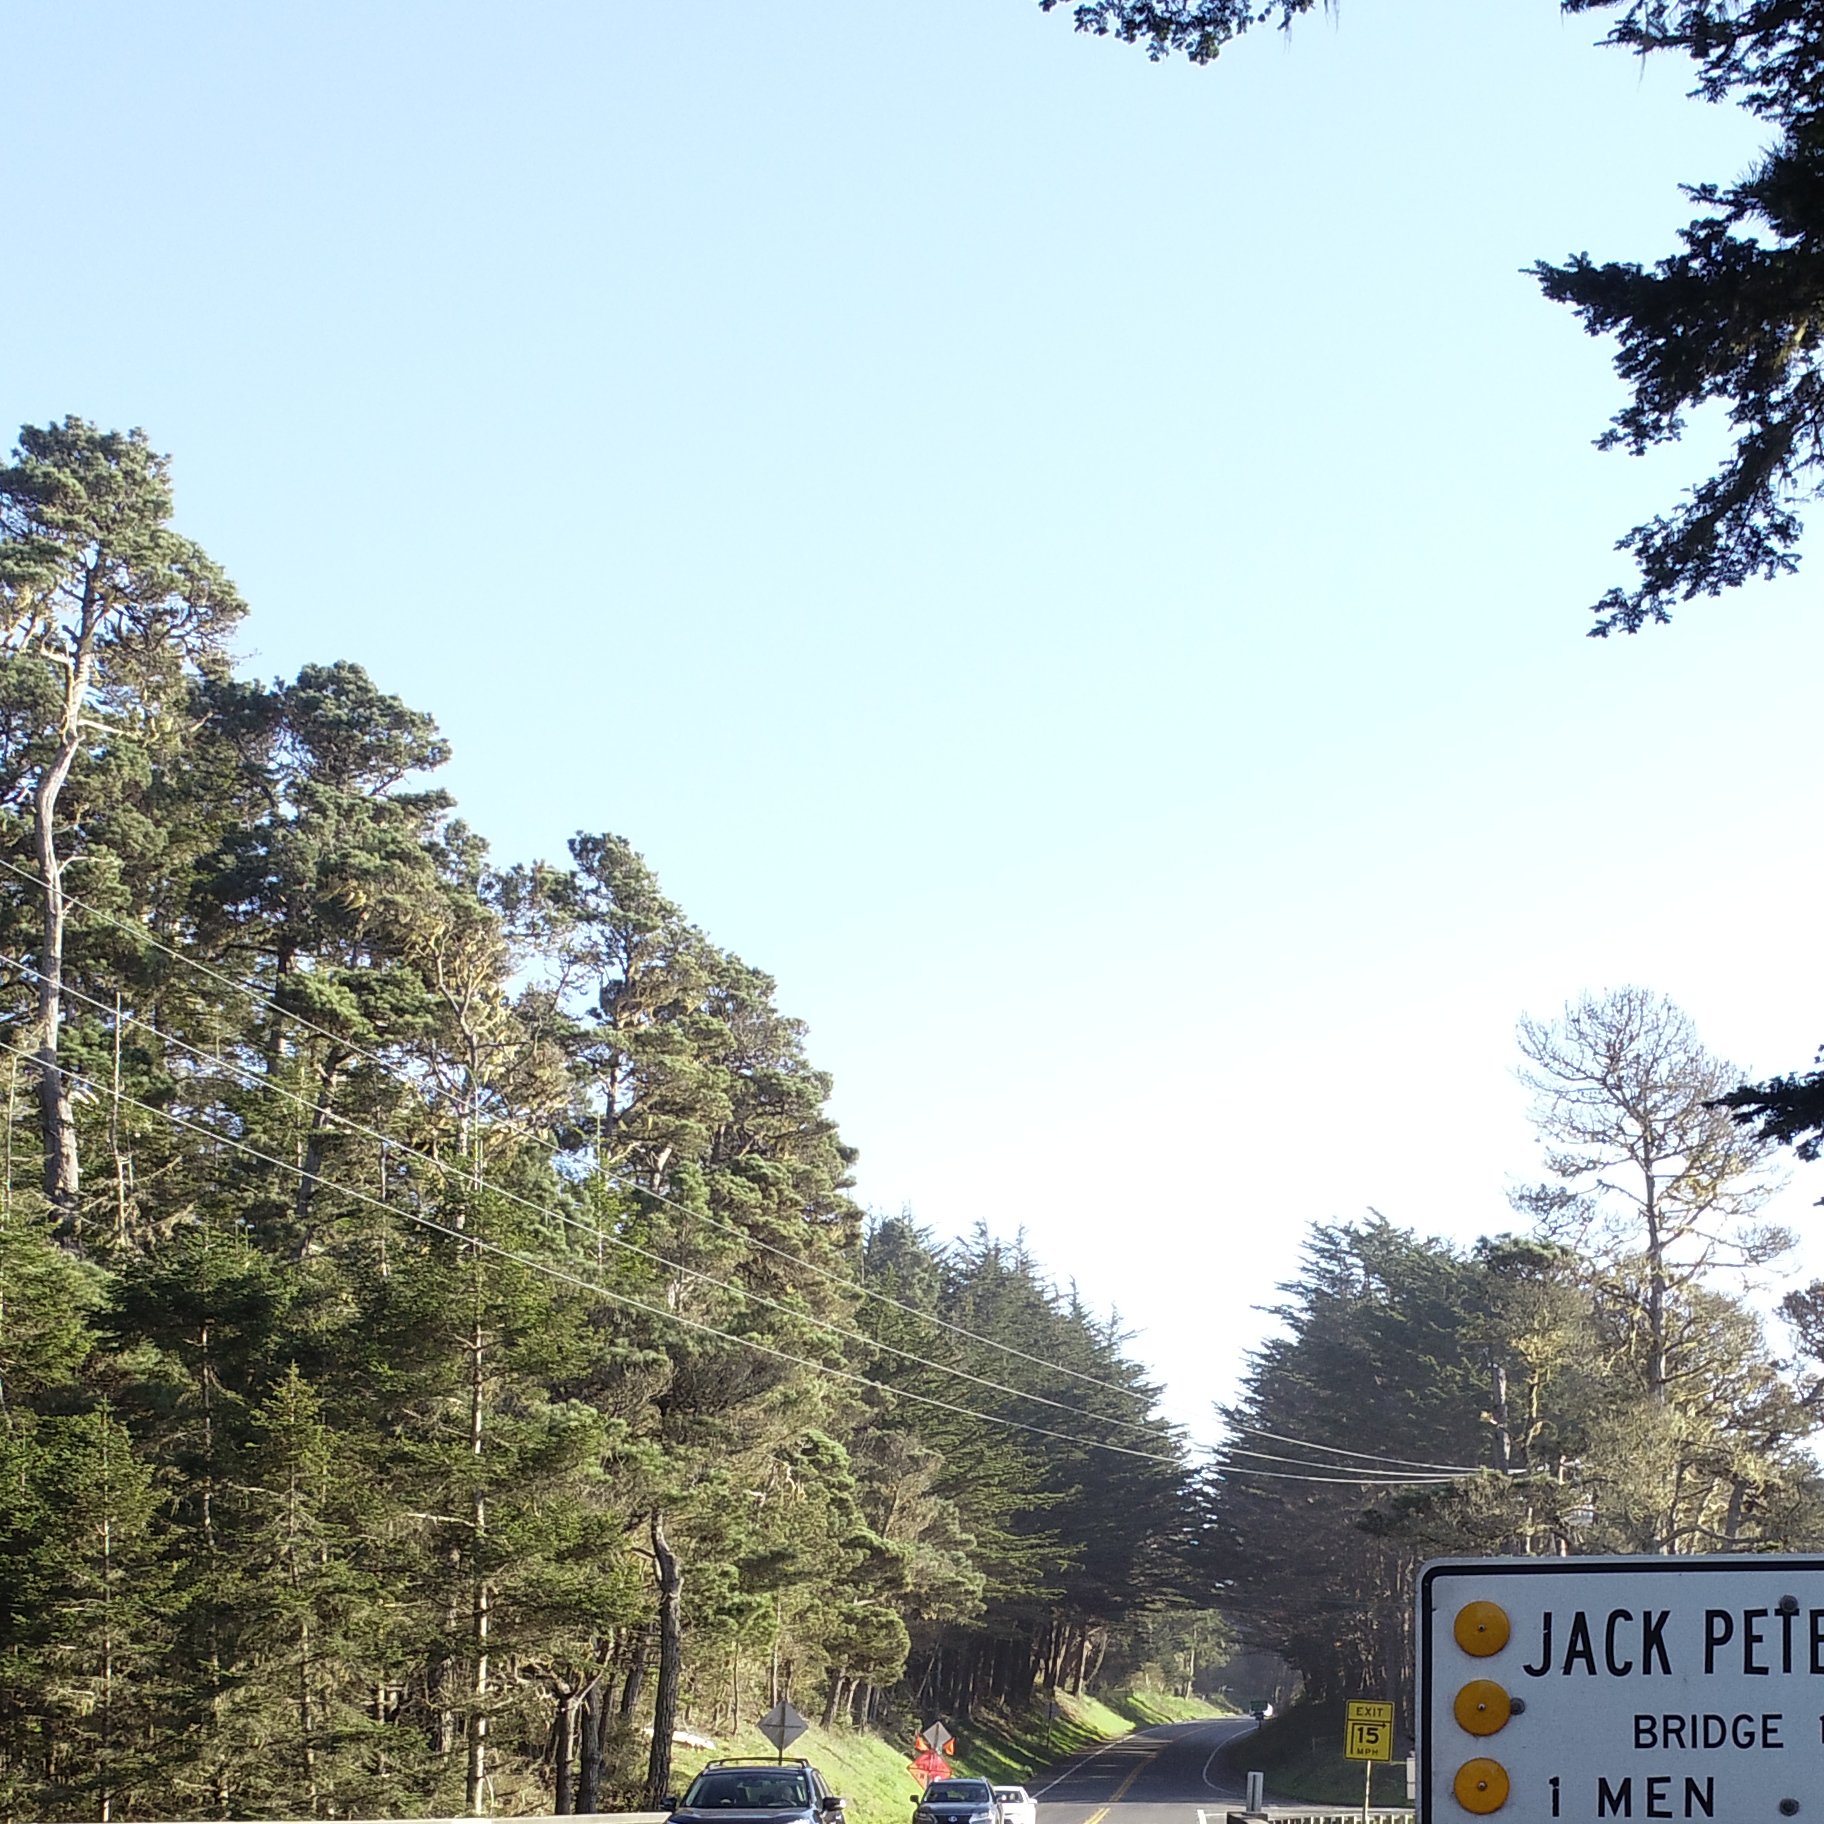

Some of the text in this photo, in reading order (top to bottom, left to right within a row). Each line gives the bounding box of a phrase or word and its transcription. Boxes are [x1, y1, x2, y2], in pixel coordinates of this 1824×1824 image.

[1522, 1608, 1673, 1677] JACK
[1356, 1706, 1384, 1718] EXIT
[1357, 1726, 1380, 1744] 15
[1633, 1714, 1784, 1749] BRIDGE
[1356, 1747, 1379, 1756] MPH
[1548, 1776, 1560, 1818] 1
[1597, 1776, 1715, 1819] MEN
